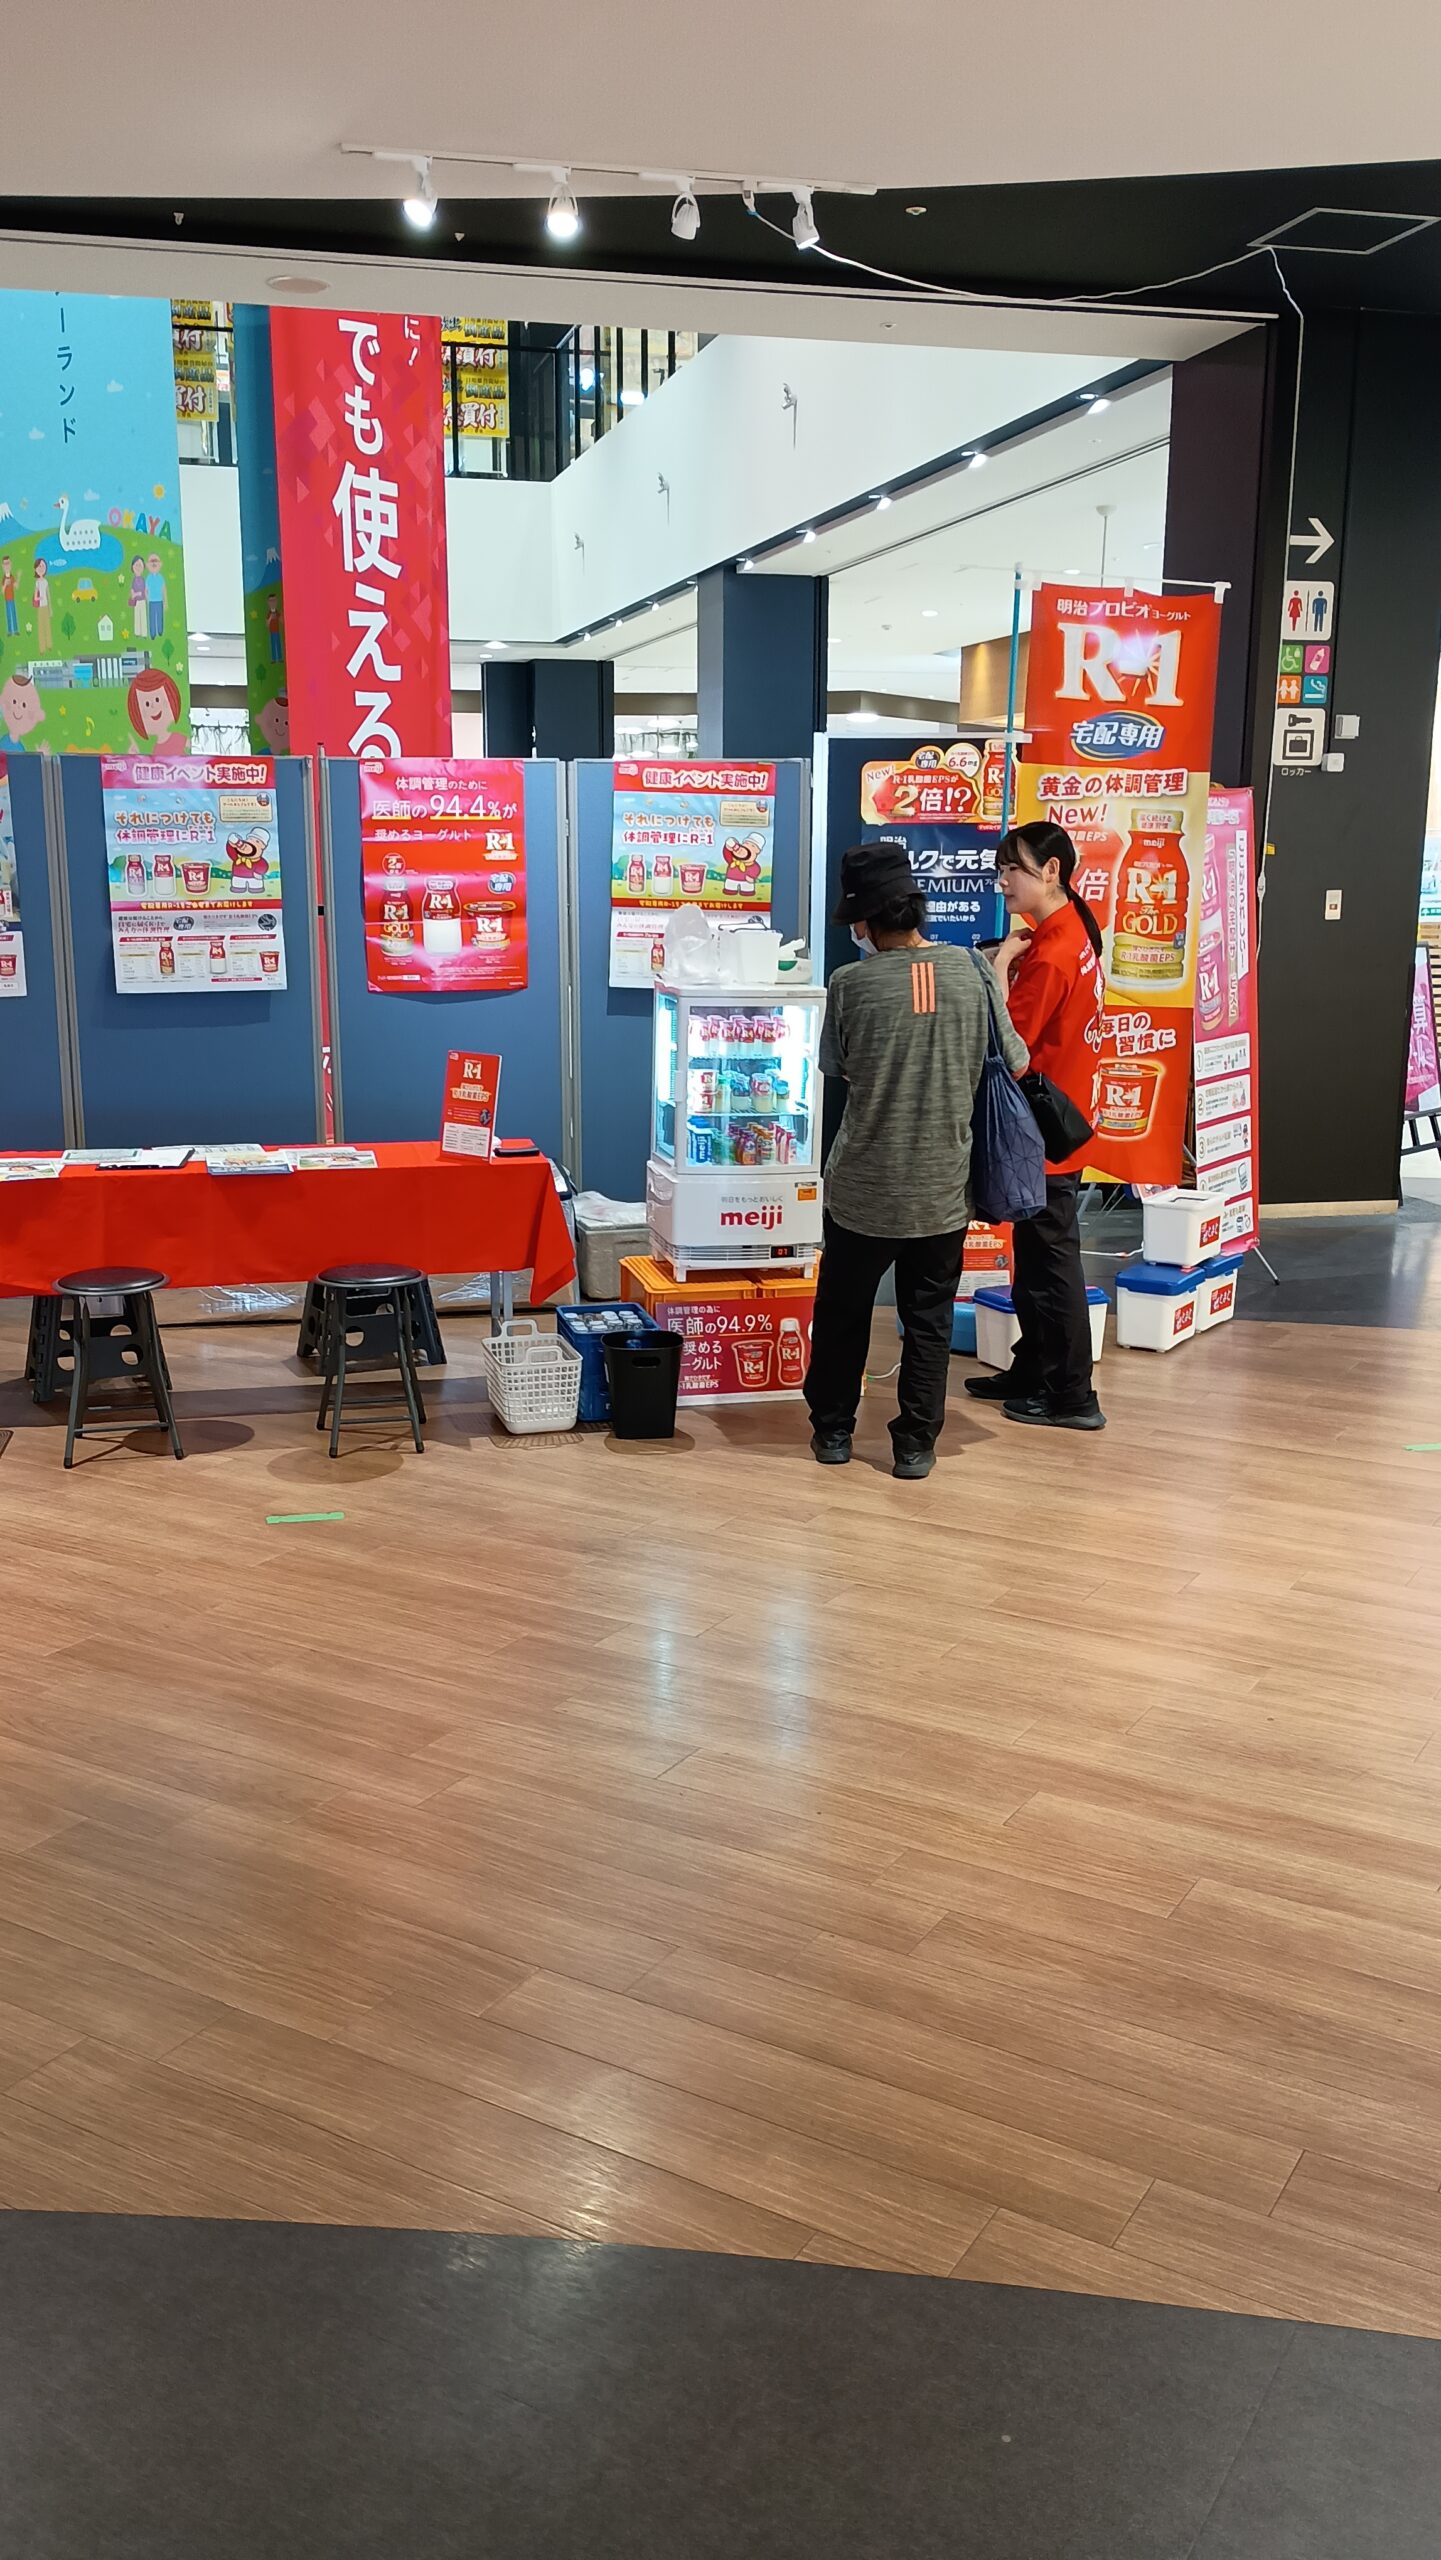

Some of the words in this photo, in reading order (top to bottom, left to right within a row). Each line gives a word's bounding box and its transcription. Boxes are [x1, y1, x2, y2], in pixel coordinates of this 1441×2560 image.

[54, 293, 77, 443] ーランド
[108, 507, 172, 543] OKAYA
[332, 318, 403, 758] でも使える
[1055, 622, 1185, 707] R-1
[1070, 720, 1165, 749] 宅配専用
[134, 763, 267, 783] 健康イベント実施中!
[644, 771, 767, 788] 健康イベント実施中!
[866, 765, 895, 782] New!
[1281, 766, 1312, 777] ロッカー
[395, 777, 489, 790] 体調管理のために
[1040, 771, 1185, 797] 黄金の体調管理
[372, 794, 518, 819] 医師の94.4%が
[894, 785, 973, 817] 2倍!?
[114, 811, 217, 826] それにつけても
[623, 814, 714, 828] それにつけても
[1048, 804, 1108, 825] New!
[116, 828, 216, 844] 体調管理にR-1
[485, 832, 515, 850] R-1
[623, 833, 714, 845] 体調管理にR-1
[1076, 868, 1109, 902] 倍
[1125, 867, 1178, 906] R-1
[429, 893, 454, 909] R-1
[384, 904, 410, 920] R-1
[476, 917, 503, 932] R-1
[1122, 911, 1178, 935] GOLD
[1100, 1014, 1148, 1034] 毎日の
[1119, 1031, 1175, 1054] 習慣に
[463, 1062, 482, 1079] R-1
[1105, 1084, 1142, 1106] R-1
[720, 1205, 783, 1230] meiji
[667, 1306, 721, 1315] 体調管理の為に
[667, 1314, 773, 1337] 医師の94.9%
[683, 1340, 723, 1356] 奨める
[781, 1348, 800, 1360] R-1
[743, 1360, 765, 1374] R-1
